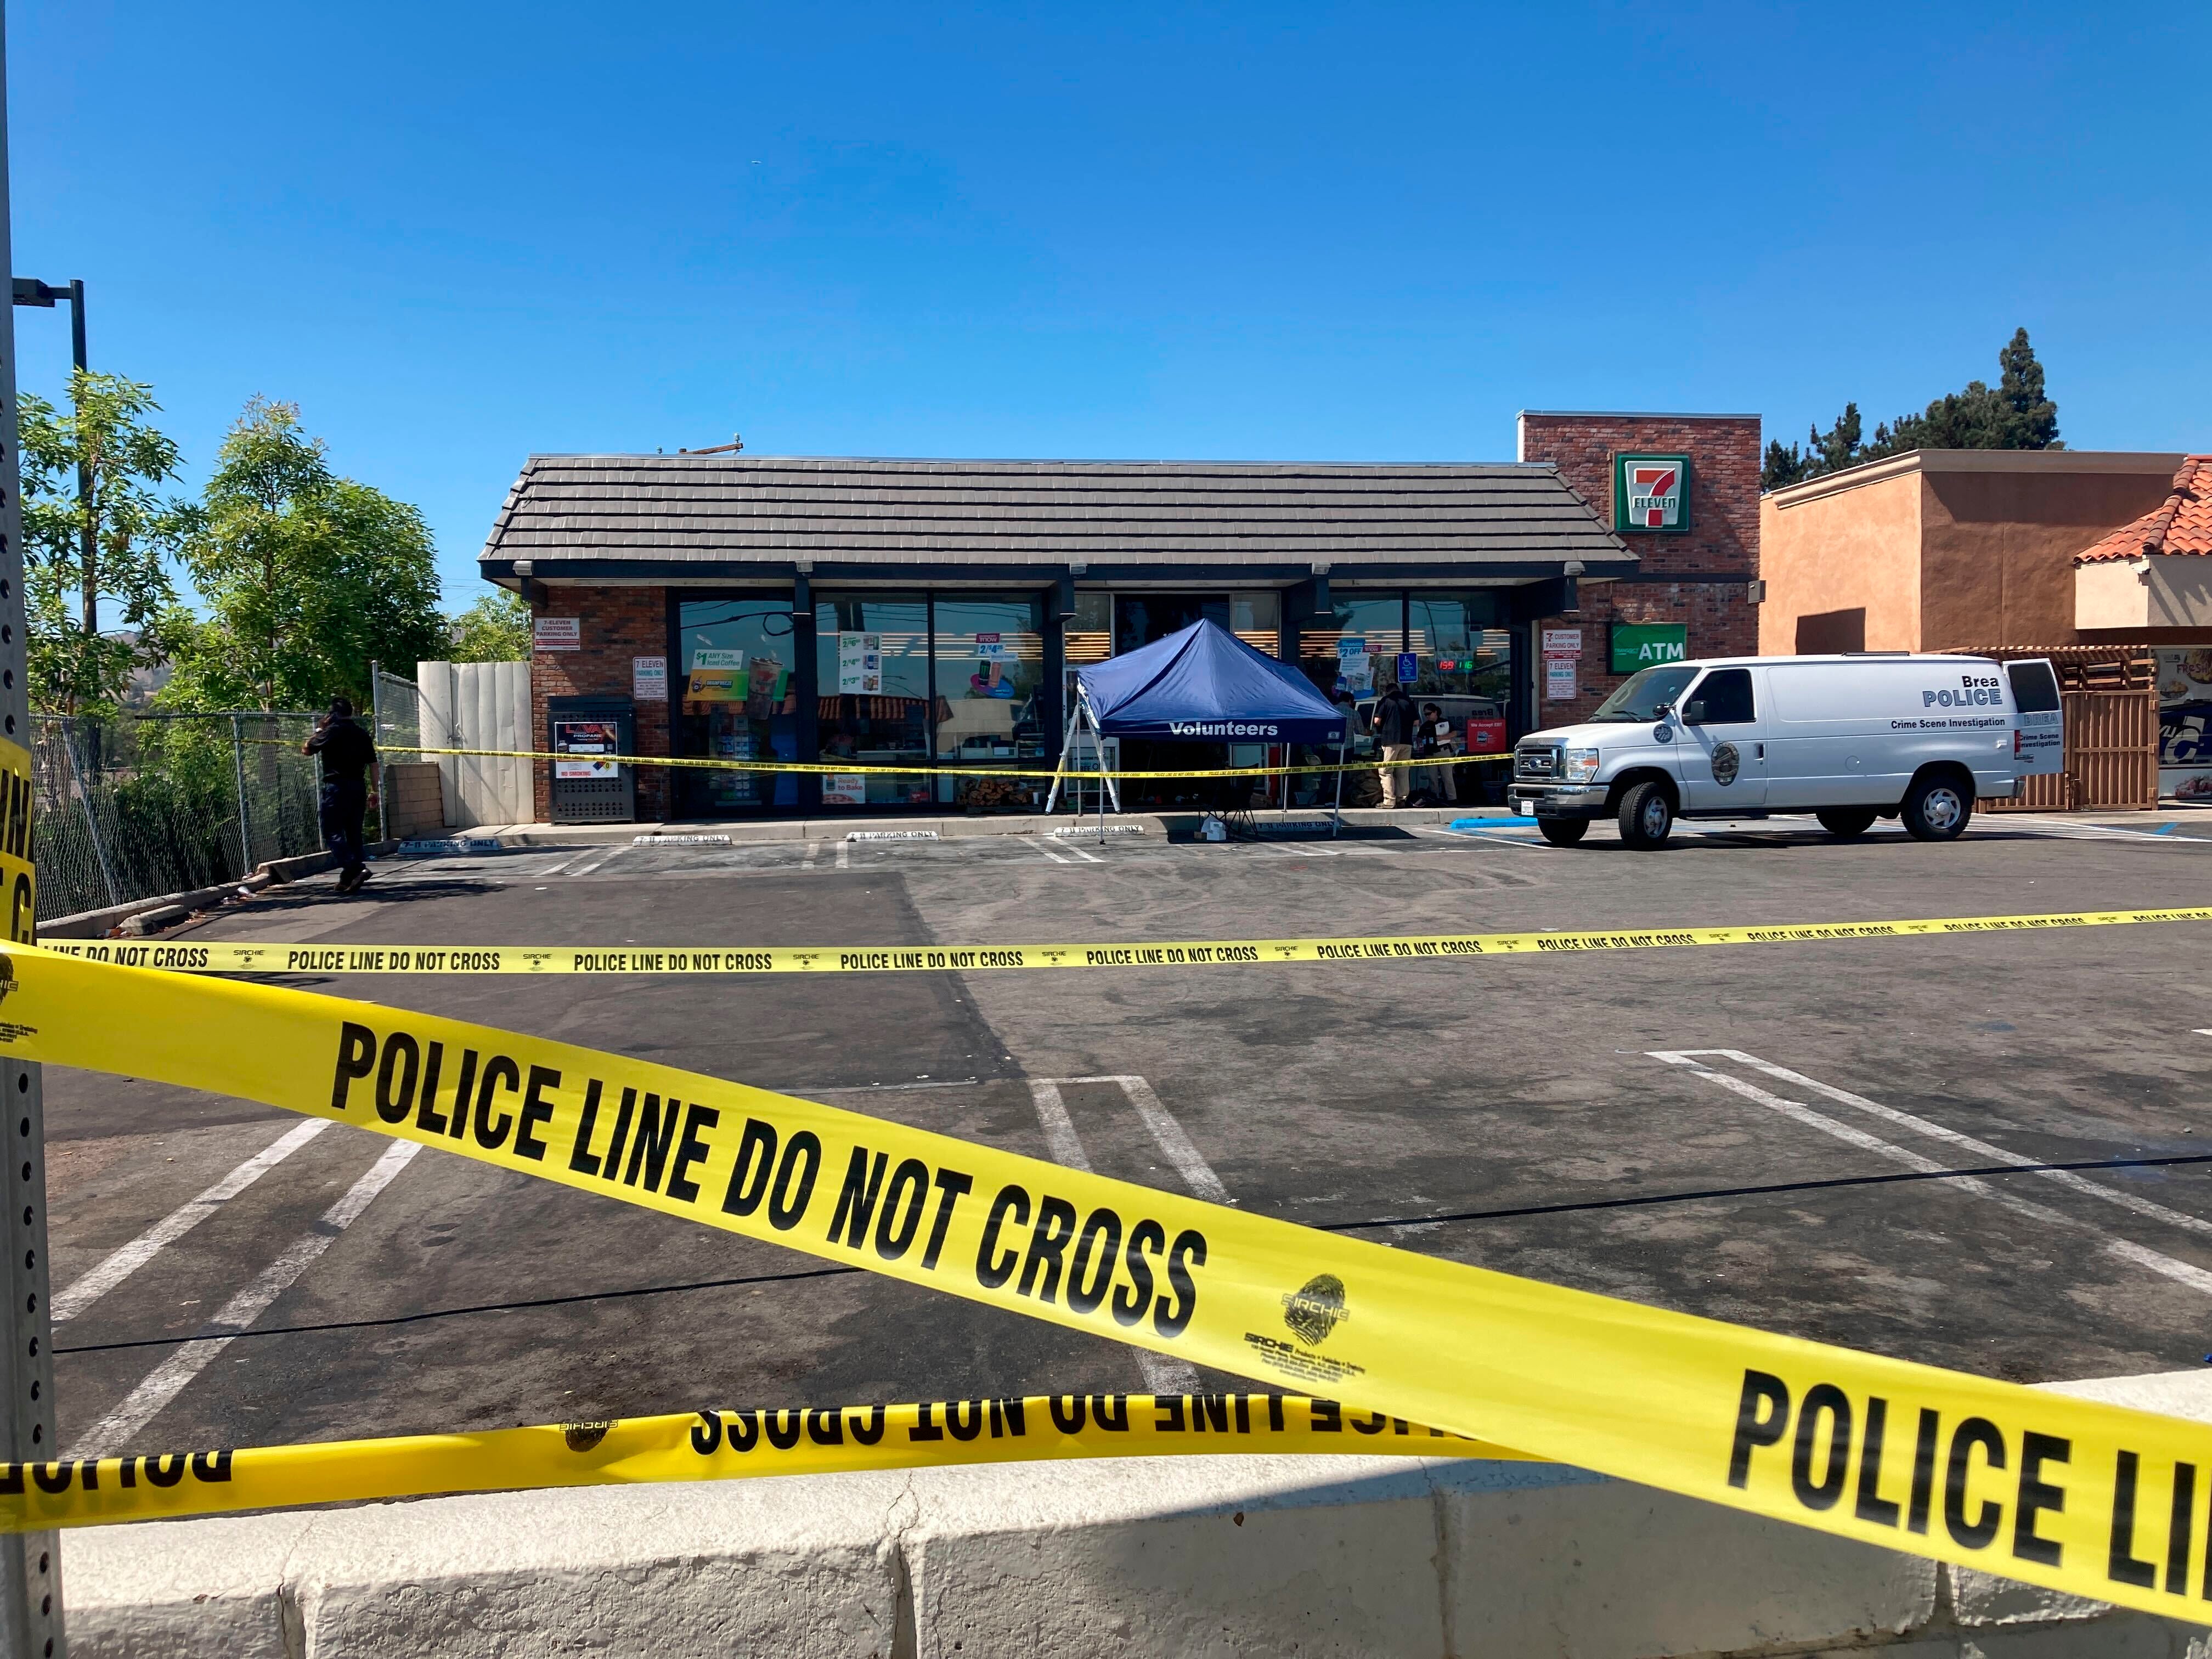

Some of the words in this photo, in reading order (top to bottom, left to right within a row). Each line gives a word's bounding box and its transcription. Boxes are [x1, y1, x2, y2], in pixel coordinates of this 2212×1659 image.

[1633, 467, 1675, 526] 7
[697, 652, 707, 665] $1
[1638, 642, 1684, 660] ATM
[1962, 675, 1999, 688] Brea
[1922, 689, 2002, 707] POLICE
[566, 724, 602, 733] LAVA
[1169, 721, 1278, 736] Volunteers
[1891, 720, 1917, 729] Crime
[1920, 719, 1946, 728] Scene
[1949, 718, 2005, 729] Investigation
[2024, 713, 2058, 726] BREA
[425, 840, 466, 848] PARKING
[470, 839, 495, 848] ONLY
[1317, 945, 1362, 958] POLICE
[1363, 944, 1392, 956] LINE
[1393, 943, 1412, 955] DO
[1414, 942, 1442, 955] NOT
[1443, 941, 1483, 953] CROSS
[1537, 939, 1582, 950] POLICE
[1581, 938, 1609, 949] LINE
[1610, 937, 1628, 947] DO
[1630, 936, 1655, 946] NOT
[1656, 934, 1697, 945] CROSS
[115, 947, 150, 966] NOT
[154, 948, 209, 968] CROSS
[288, 951, 344, 969] POLICE
[350, 952, 383, 969] LINE
[390, 952, 409, 970] DO
[415, 952, 445, 970] NOT
[451, 952, 500, 970] CROSS
[575, 954, 626, 970] POLICE
[633, 955, 663, 970] LINE
[669, 954, 687, 970] DO
[693, 954, 720, 970] NOT
[726, 953, 771, 969] CROSS
[841, 954, 889, 969] POLICE
[894, 953, 923, 968] LINE
[928, 952, 945, 967] DO
[950, 952, 975, 967] NOT
[980, 951, 1023, 966] CROSS
[1087, 950, 1132, 964] POLICE
[1136, 950, 1164, 963] LINE
[1167, 949, 1184, 962] DO
[1188, 948, 1212, 962] NOT
[1217, 946, 1258, 961] CROSS
[331, 1021, 561, 1160] POLICE
[569, 1079, 720, 1203] LINE
[722, 1118, 821, 1231] DO
[827, 1146, 974, 1271] NOT
[976, 1184, 1207, 1338] CROSS
[1281, 1293, 1350, 1322] SIRCHIE
[1244, 1332, 1294, 1353] SIRCHIE
[1728, 1369, 2072, 1569] POLICE
